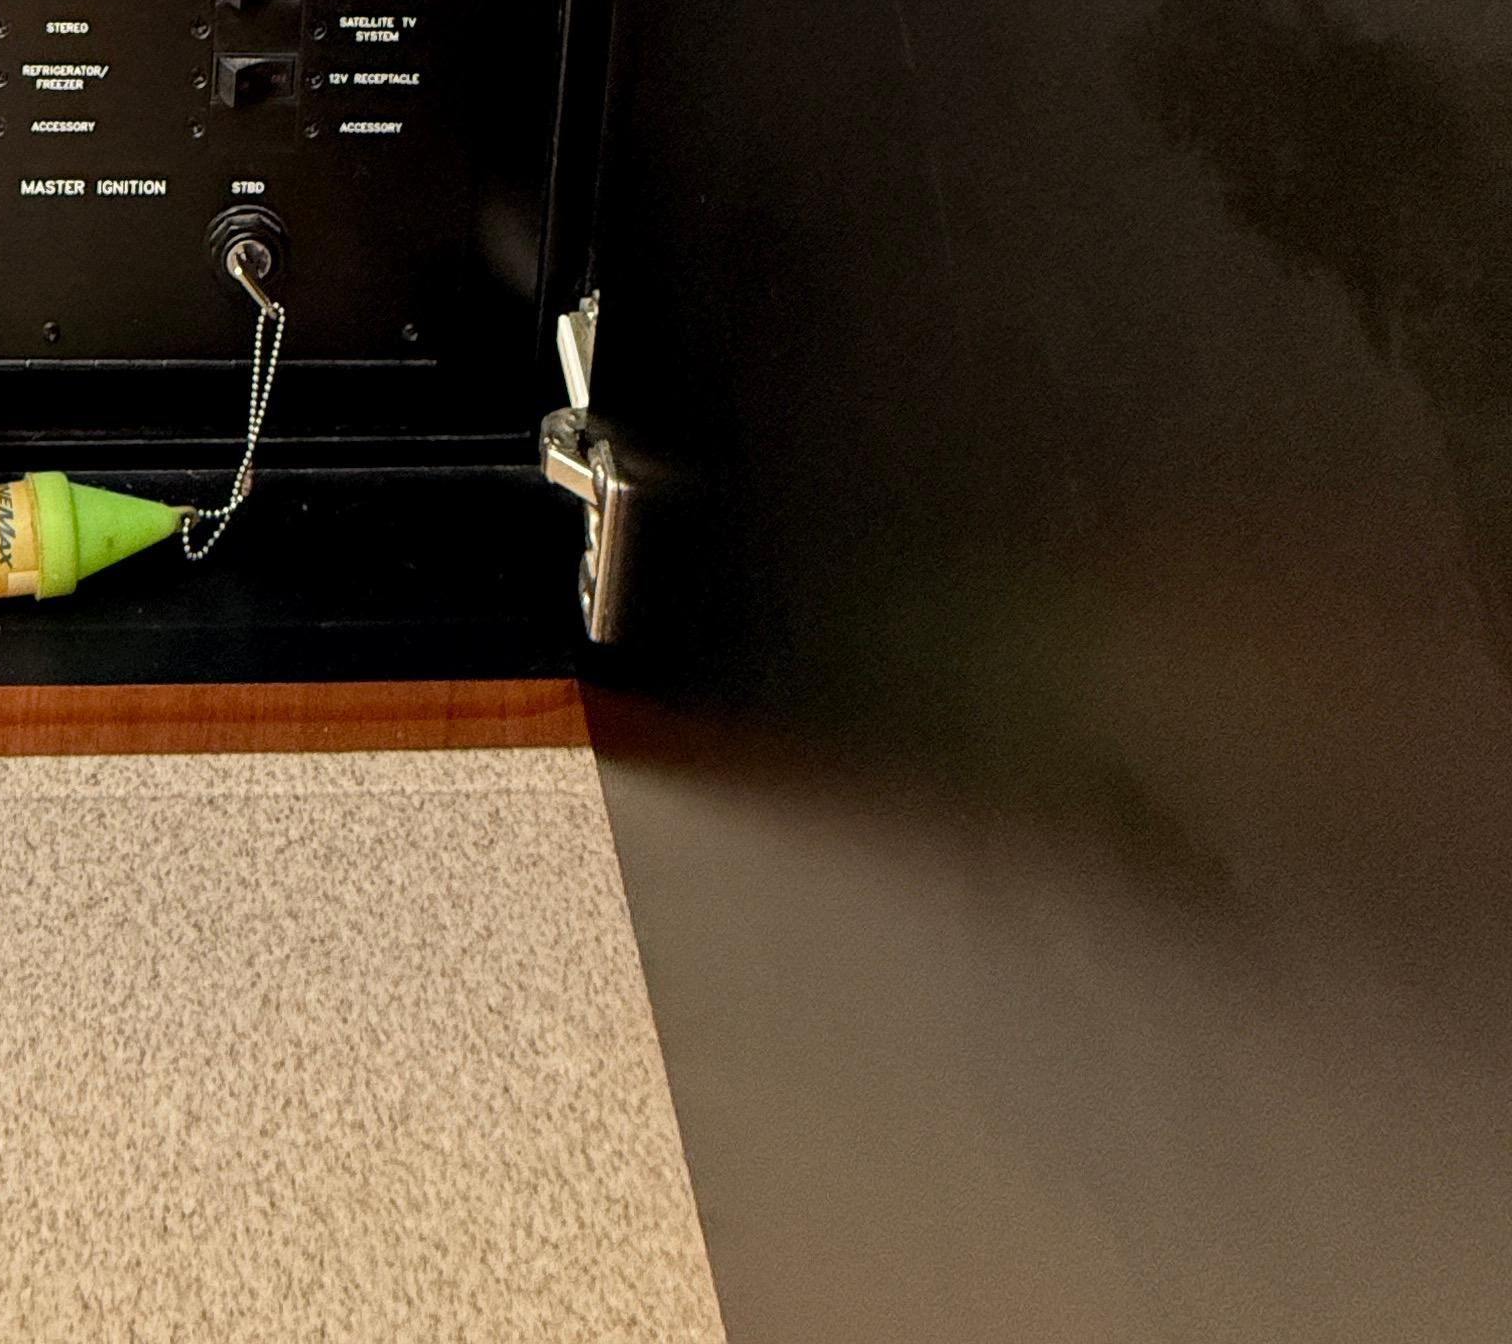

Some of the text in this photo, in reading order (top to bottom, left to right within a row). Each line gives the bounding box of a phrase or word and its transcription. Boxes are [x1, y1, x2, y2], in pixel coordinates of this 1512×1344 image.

[47, 22, 88, 33] STEREO
[340, 17, 416, 28] SATELLITE TV
[356, 31, 399, 41] SYSTEM
[23, 65, 108, 78] REFRIGERATOR/
[329, 73, 419, 84] 12V RECEPTACLE
[36, 79, 83, 90] FREEZER
[31, 121, 95, 132] ACCESSORY
[340, 122, 402, 133] ACCESSORY
[21, 180, 166, 195] MASTER IGNITION
[232, 181, 264, 193] STBD
